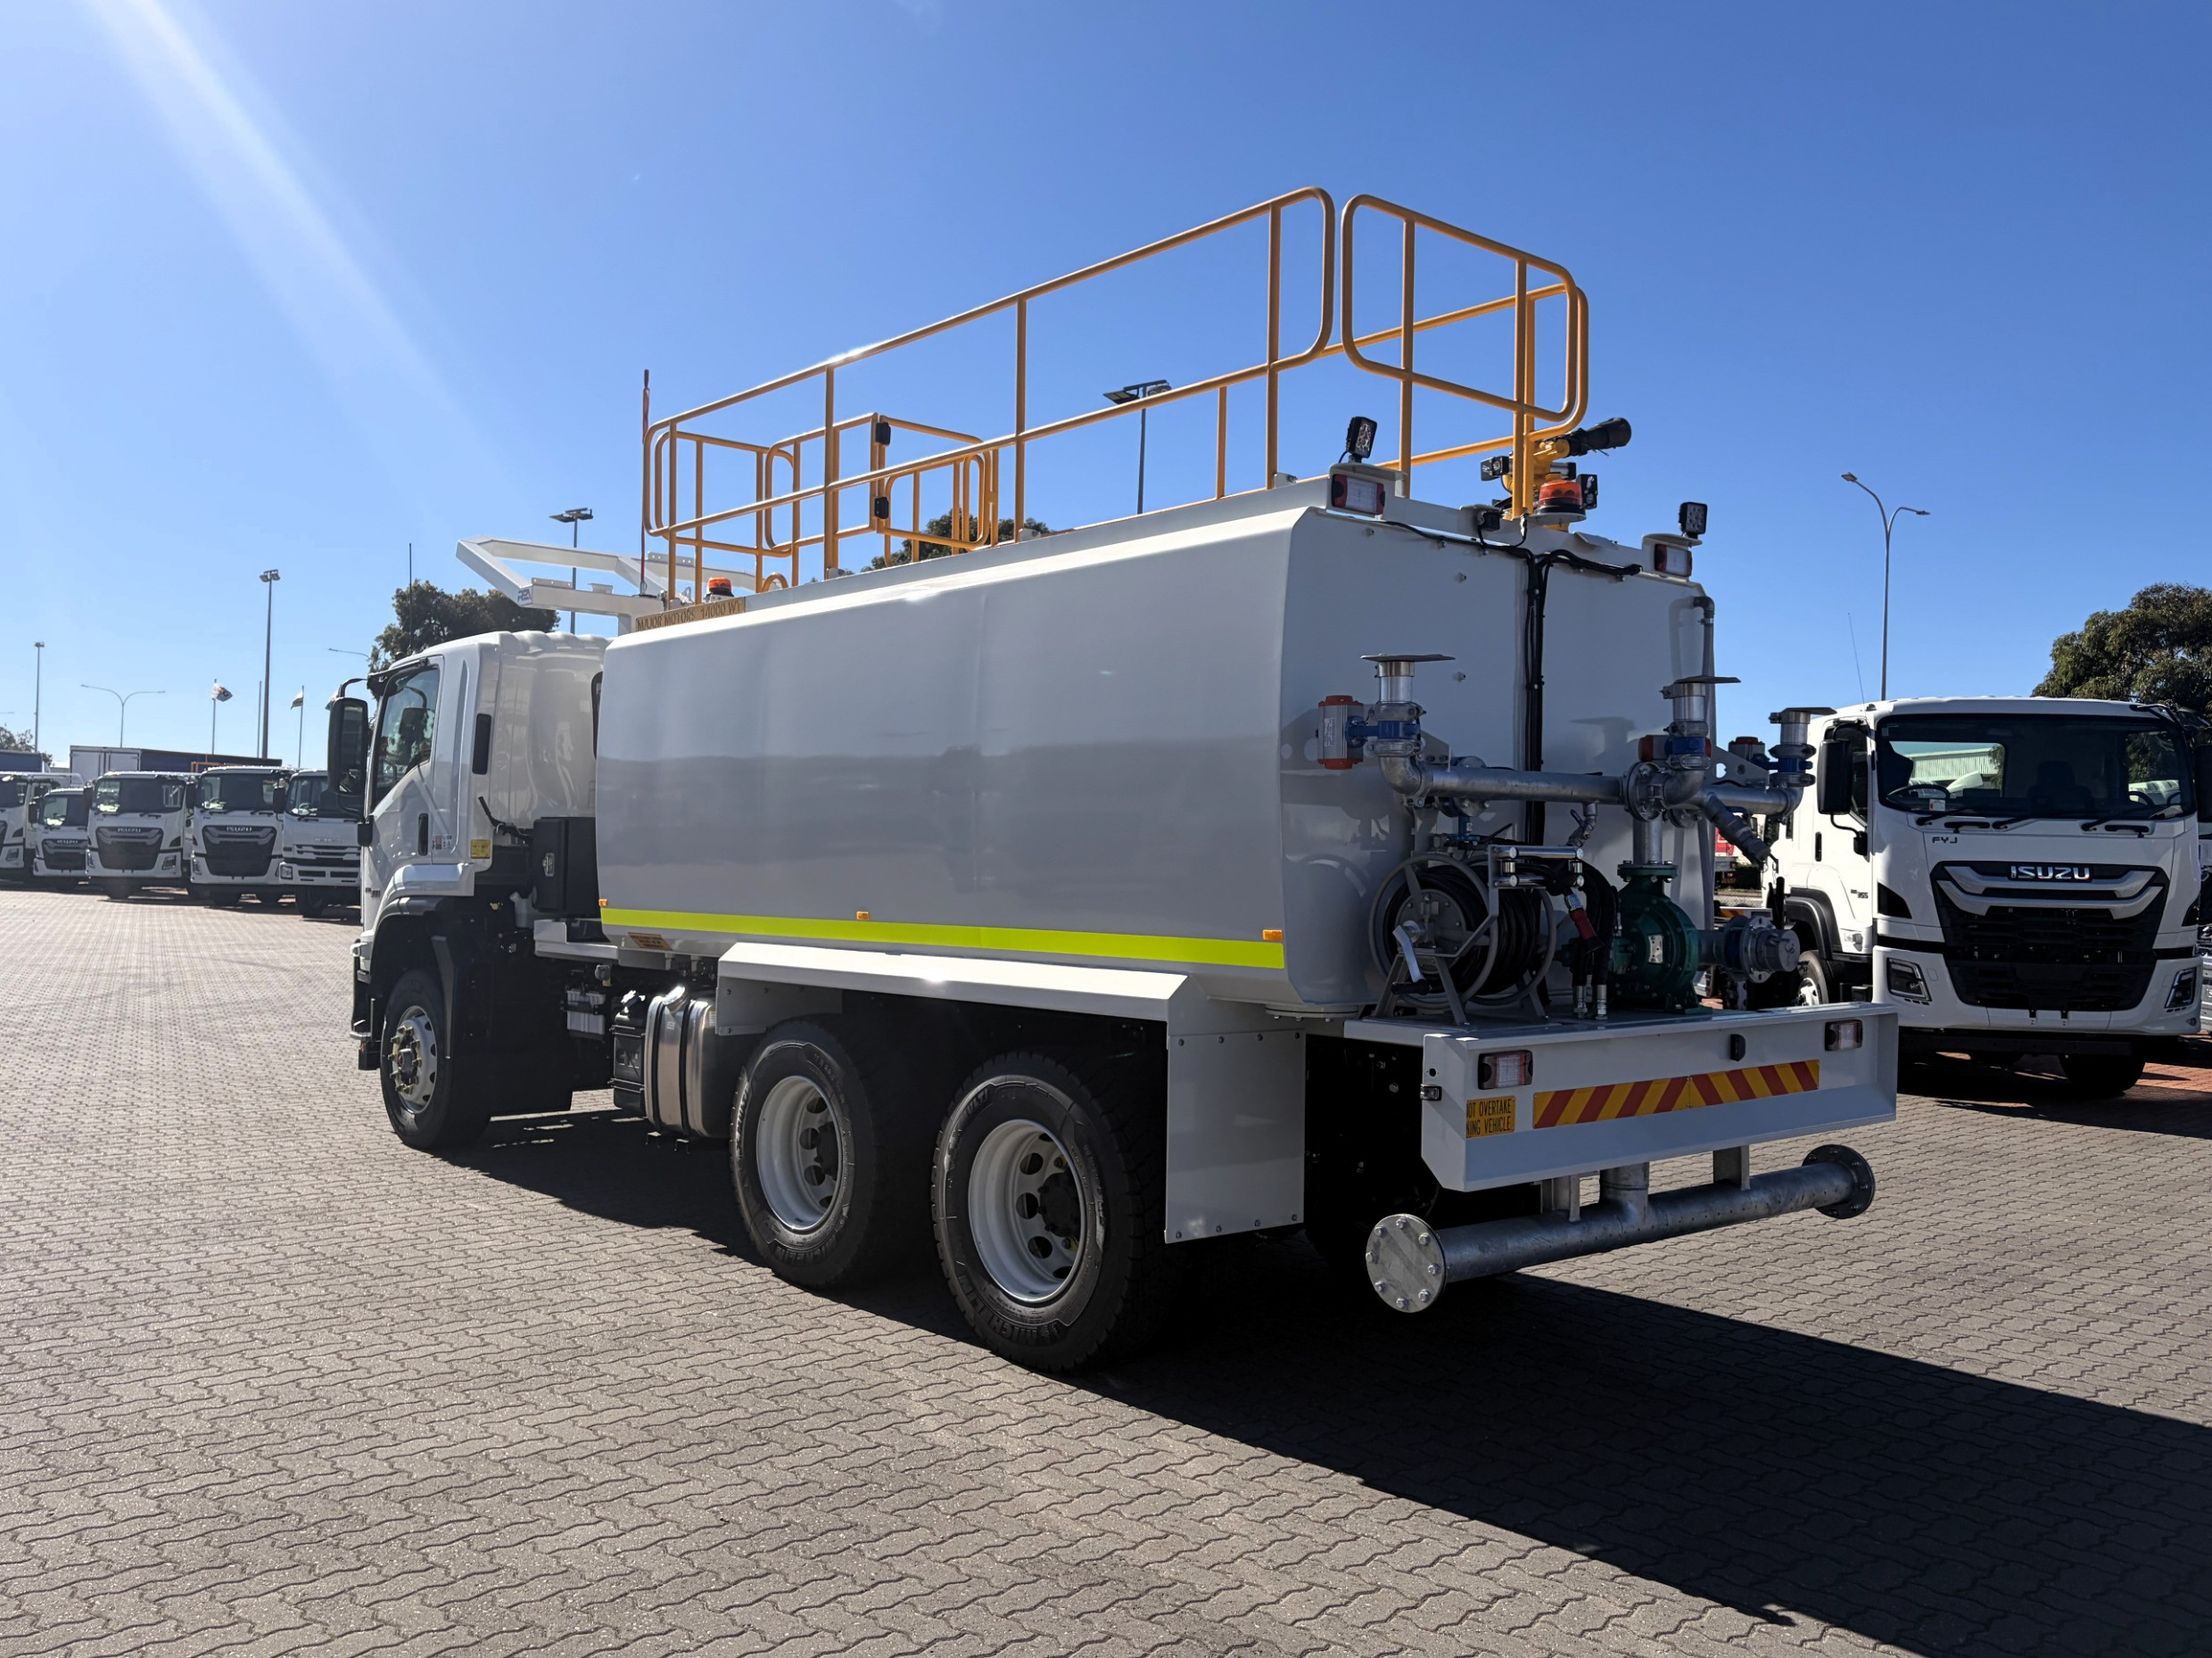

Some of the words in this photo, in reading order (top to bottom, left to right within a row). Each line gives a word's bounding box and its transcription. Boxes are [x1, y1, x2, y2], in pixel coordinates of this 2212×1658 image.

[637, 614, 662, 631] MAJOR
[664, 608, 695, 627] MOTORS
[2010, 865, 2090, 880] ISUZU
[1480, 1098, 1512, 1117] OVERTAKE
[1484, 1116, 1511, 1134] VEHICLE
